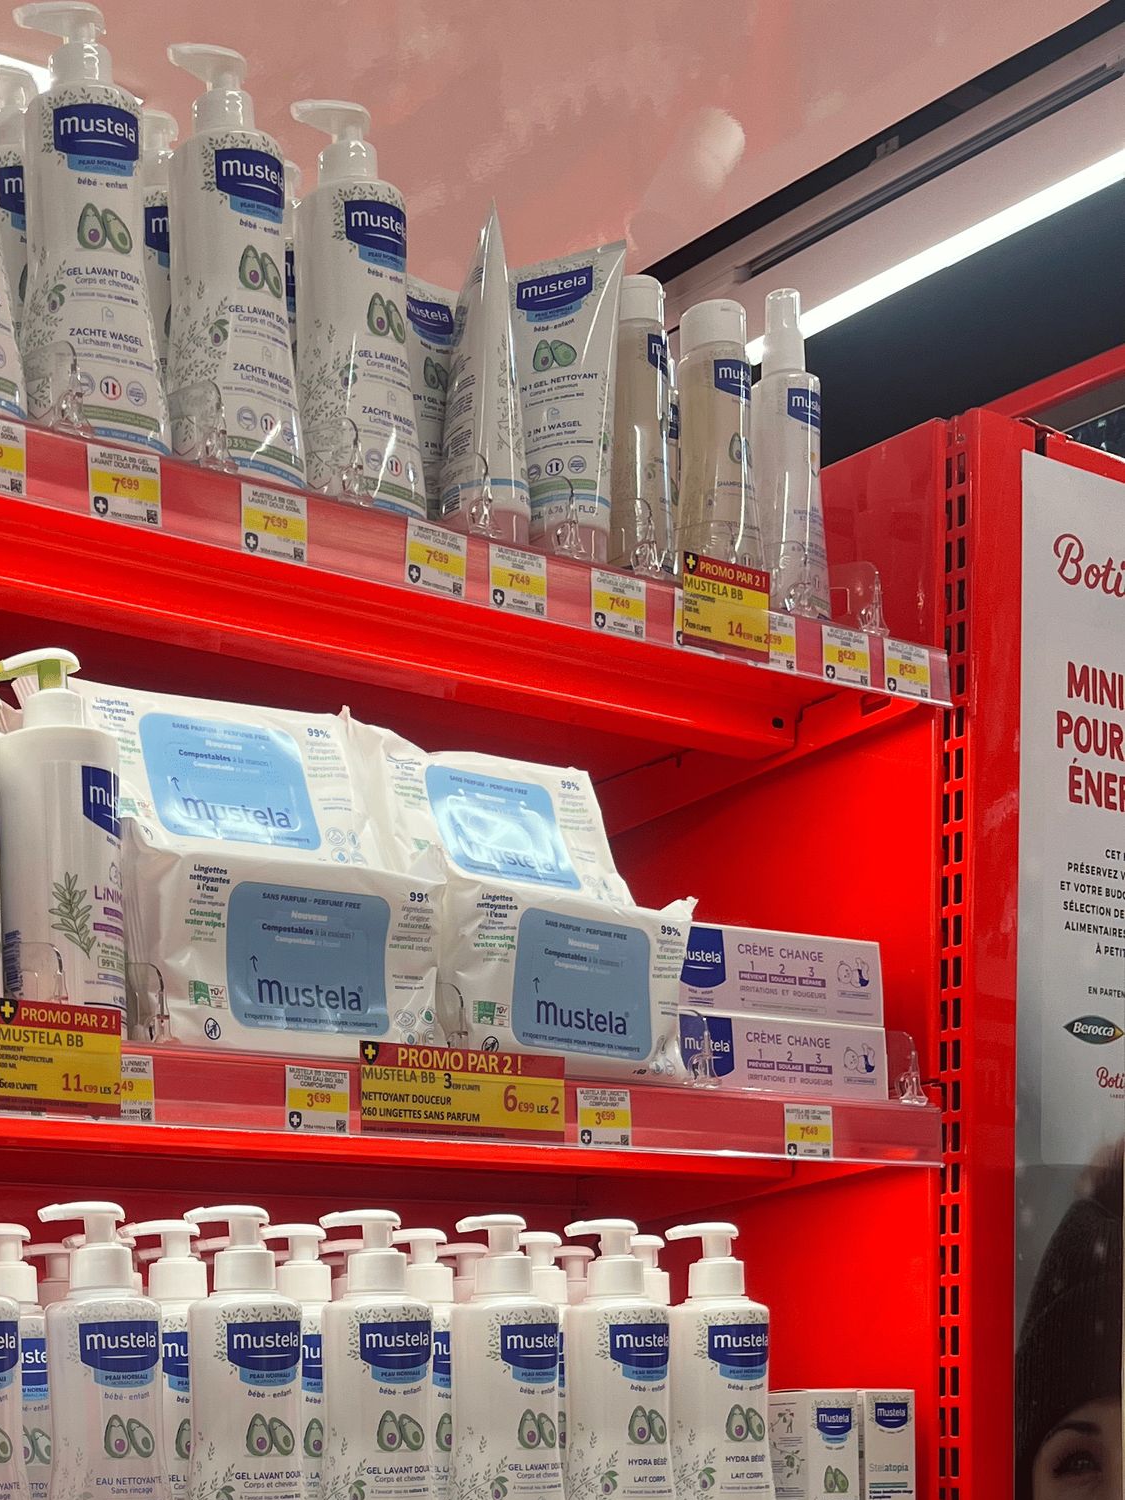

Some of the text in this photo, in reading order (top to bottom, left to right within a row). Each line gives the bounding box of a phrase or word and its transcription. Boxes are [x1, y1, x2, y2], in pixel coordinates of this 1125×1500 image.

[60, 115, 137, 144] mustela
[66, 267, 141, 285] GEL LAVANT DOUX
[522, 273, 588, 300] mustela
[69, 328, 144, 347] ZACHTE WASGEL
[111, 477, 140, 494] 7€99
[507, 572, 531, 589] 7€49
[1067, 661, 1124, 711] MINI
[307, 728, 330, 739] 99%
[1056, 710, 1124, 762] POUR
[1067, 862, 1118, 880] PRÉSERVEZ
[1060, 881, 1103, 897] ET VOTRE
[189, 908, 222, 922] Cleansing
[1063, 900, 1111, 917] SÉLECTION
[185, 918, 226, 931] water wipes
[737, 942, 823, 962] CRÈME CHANGE
[257, 975, 362, 1013] mustela
[21, 1006, 109, 1028] PROMO PAR 2
[537, 1000, 628, 1037] mustela
[1073, 1021, 1115, 1037] Berocca
[66, 1033, 84, 1047] BB
[397, 1046, 514, 1073] PROMO PAR 2
[362, 1066, 436, 1085] MUSTELA BB
[306, 1090, 331, 1108] 3€99
[361, 1088, 451, 1106] NETTOYANT DOUCEUR
[362, 1107, 480, 1124] X60 LINGETTES SANS PARFUM
[85, 1331, 156, 1350] mustela
[233, 1330, 298, 1349] mustela
[714, 1332, 769, 1349] mustela
